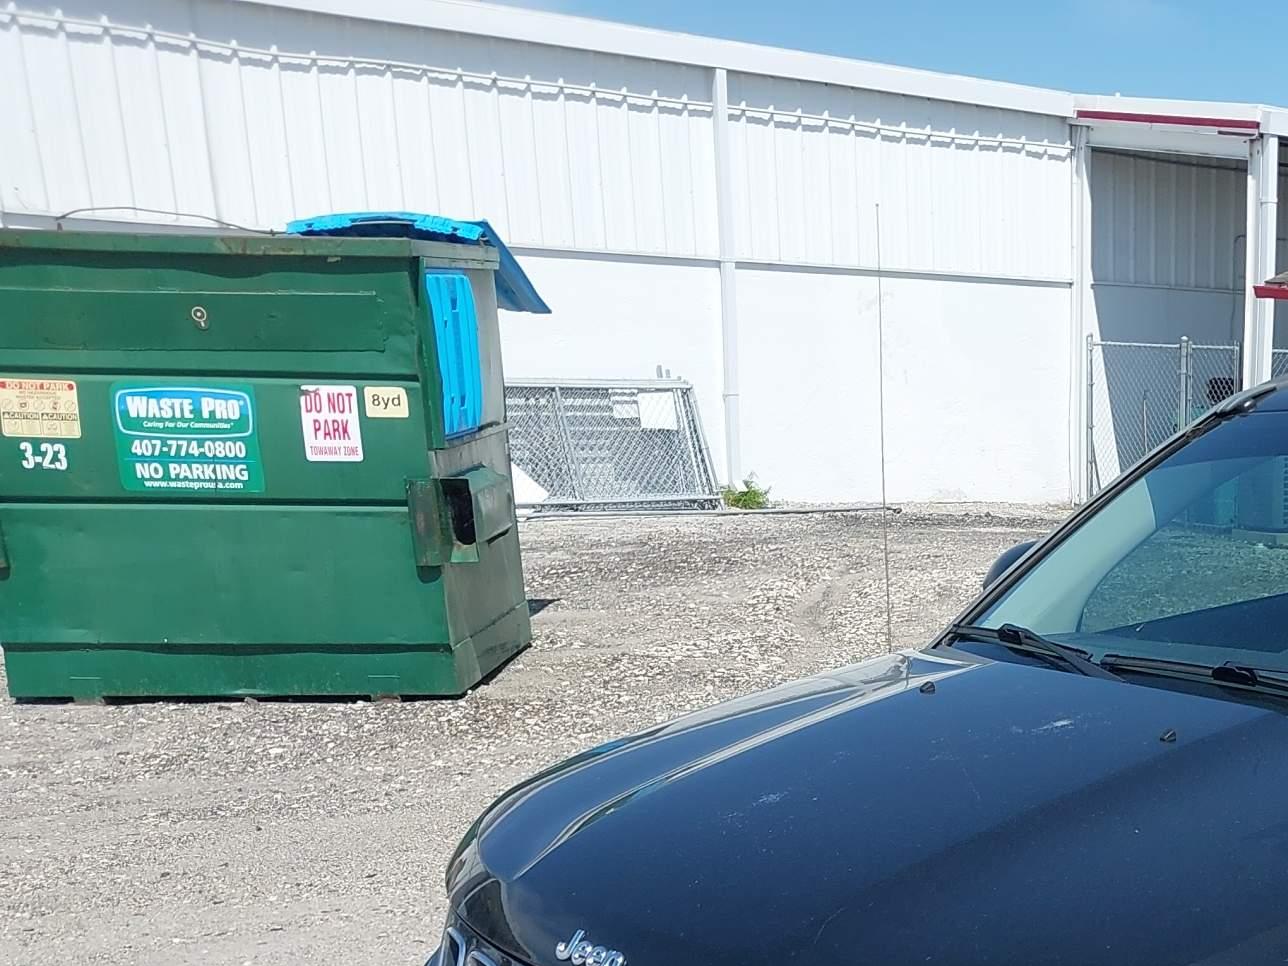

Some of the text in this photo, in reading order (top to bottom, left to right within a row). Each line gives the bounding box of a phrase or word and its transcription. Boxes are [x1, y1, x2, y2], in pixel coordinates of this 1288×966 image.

[304, 391, 353, 414] DO NOT
[371, 393, 401, 410] 8yd
[313, 419, 351, 441] PARK
[20, 441, 68, 471] 3-23
[131, 439, 246, 458] 407-774-0800
[310, 446, 360, 457] TOWAWAY ZONE
[135, 463, 249, 481] NO PARKING
